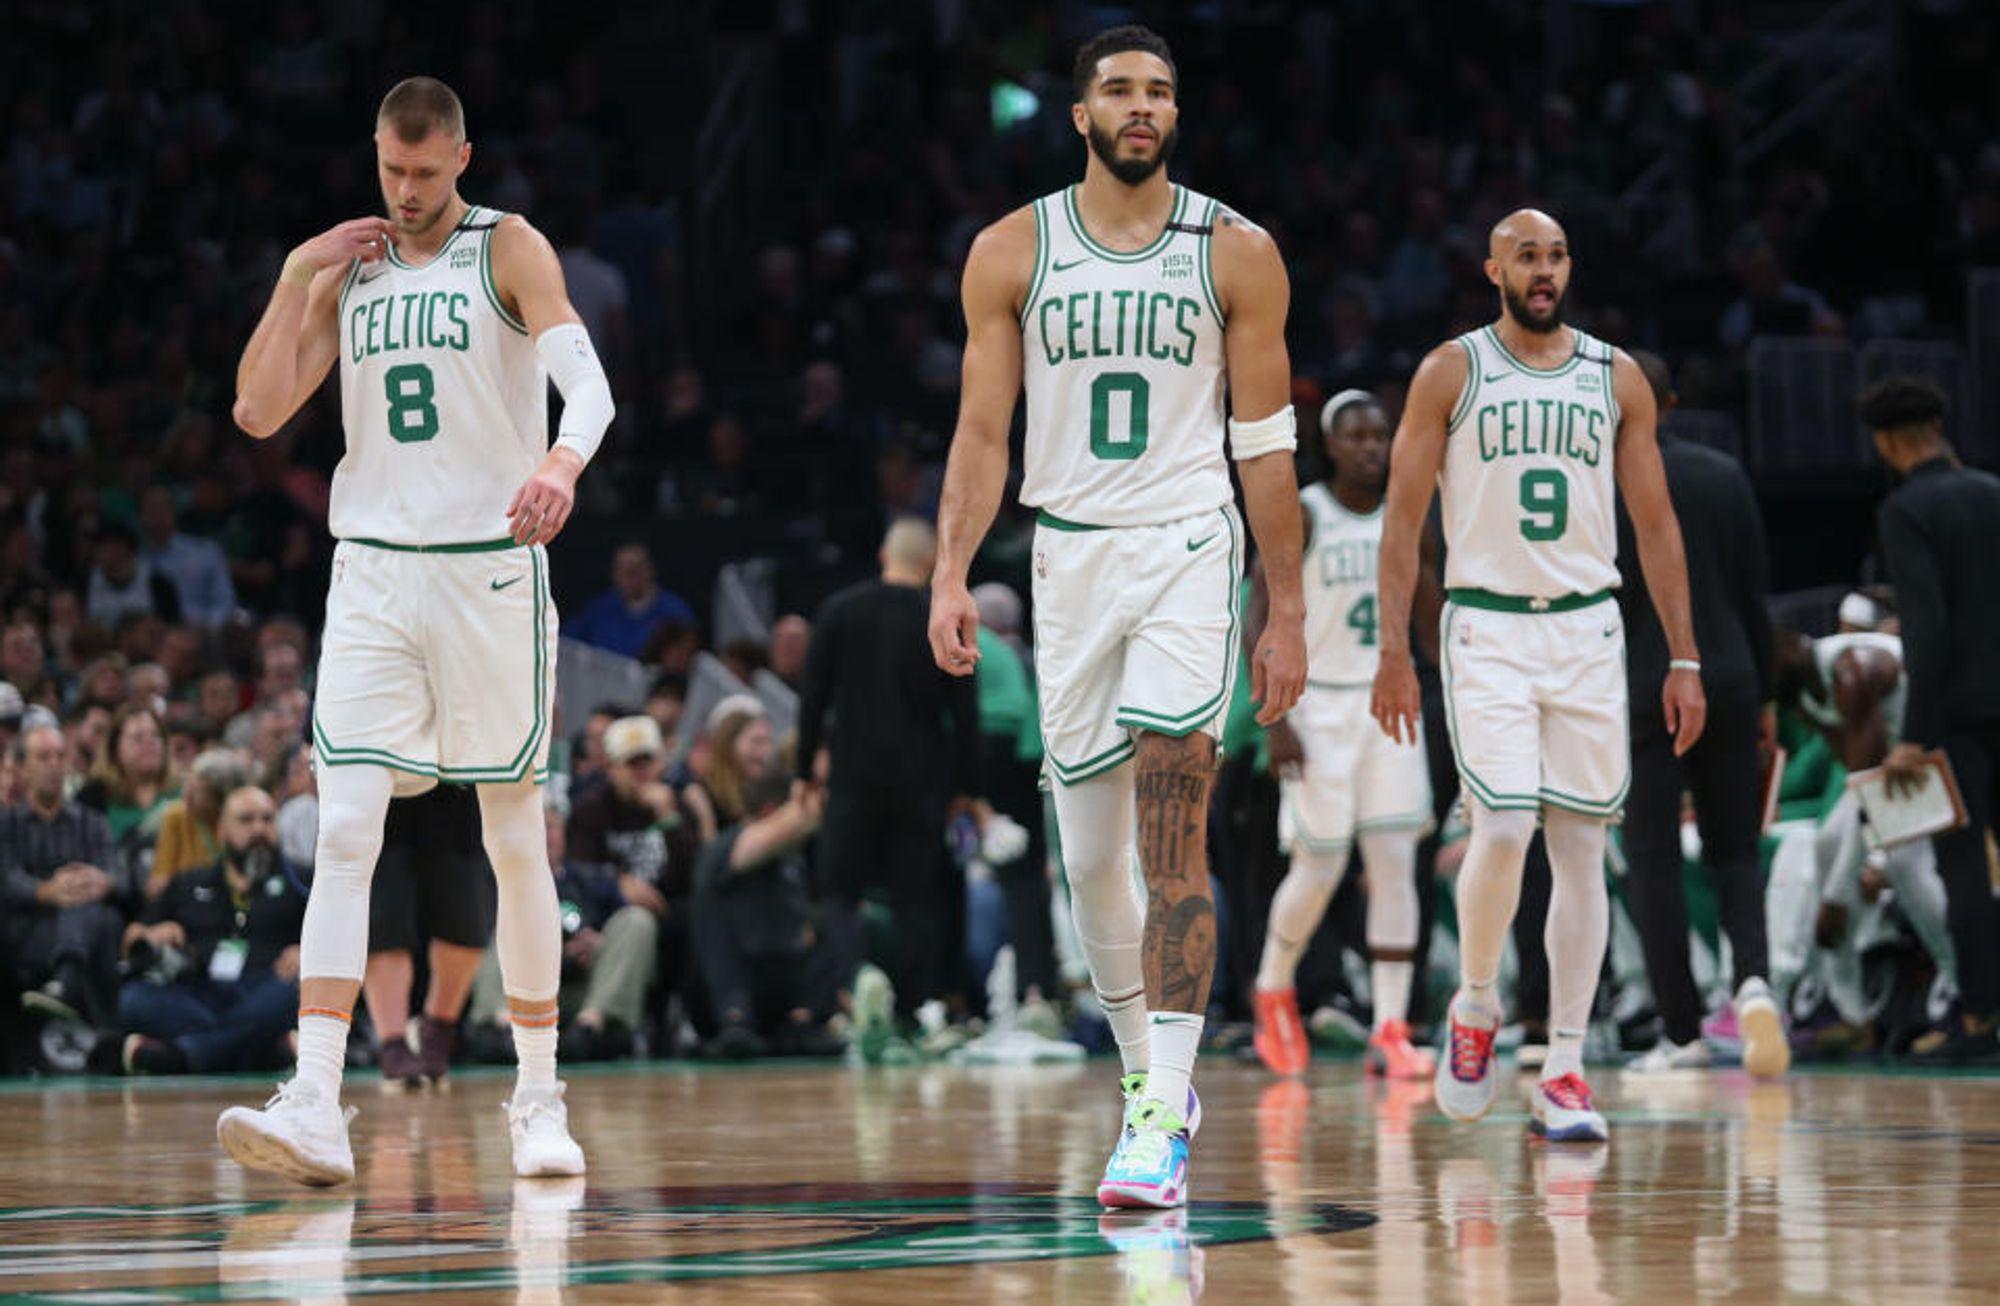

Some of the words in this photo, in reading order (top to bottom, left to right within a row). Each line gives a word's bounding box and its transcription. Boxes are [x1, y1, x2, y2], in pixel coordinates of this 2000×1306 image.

[1162, 253, 1193, 268] VISTA
[1162, 268, 1193, 279] PRINT
[351, 291, 470, 365] CELTICS
[1039, 290, 1201, 367] CELTICS
[384, 363, 440, 443] 8
[1089, 371, 1150, 461] 0
[1478, 398, 1605, 468] CELTICS
[1519, 468, 1569, 542] 9
[1346, 592, 1377, 647] 4
